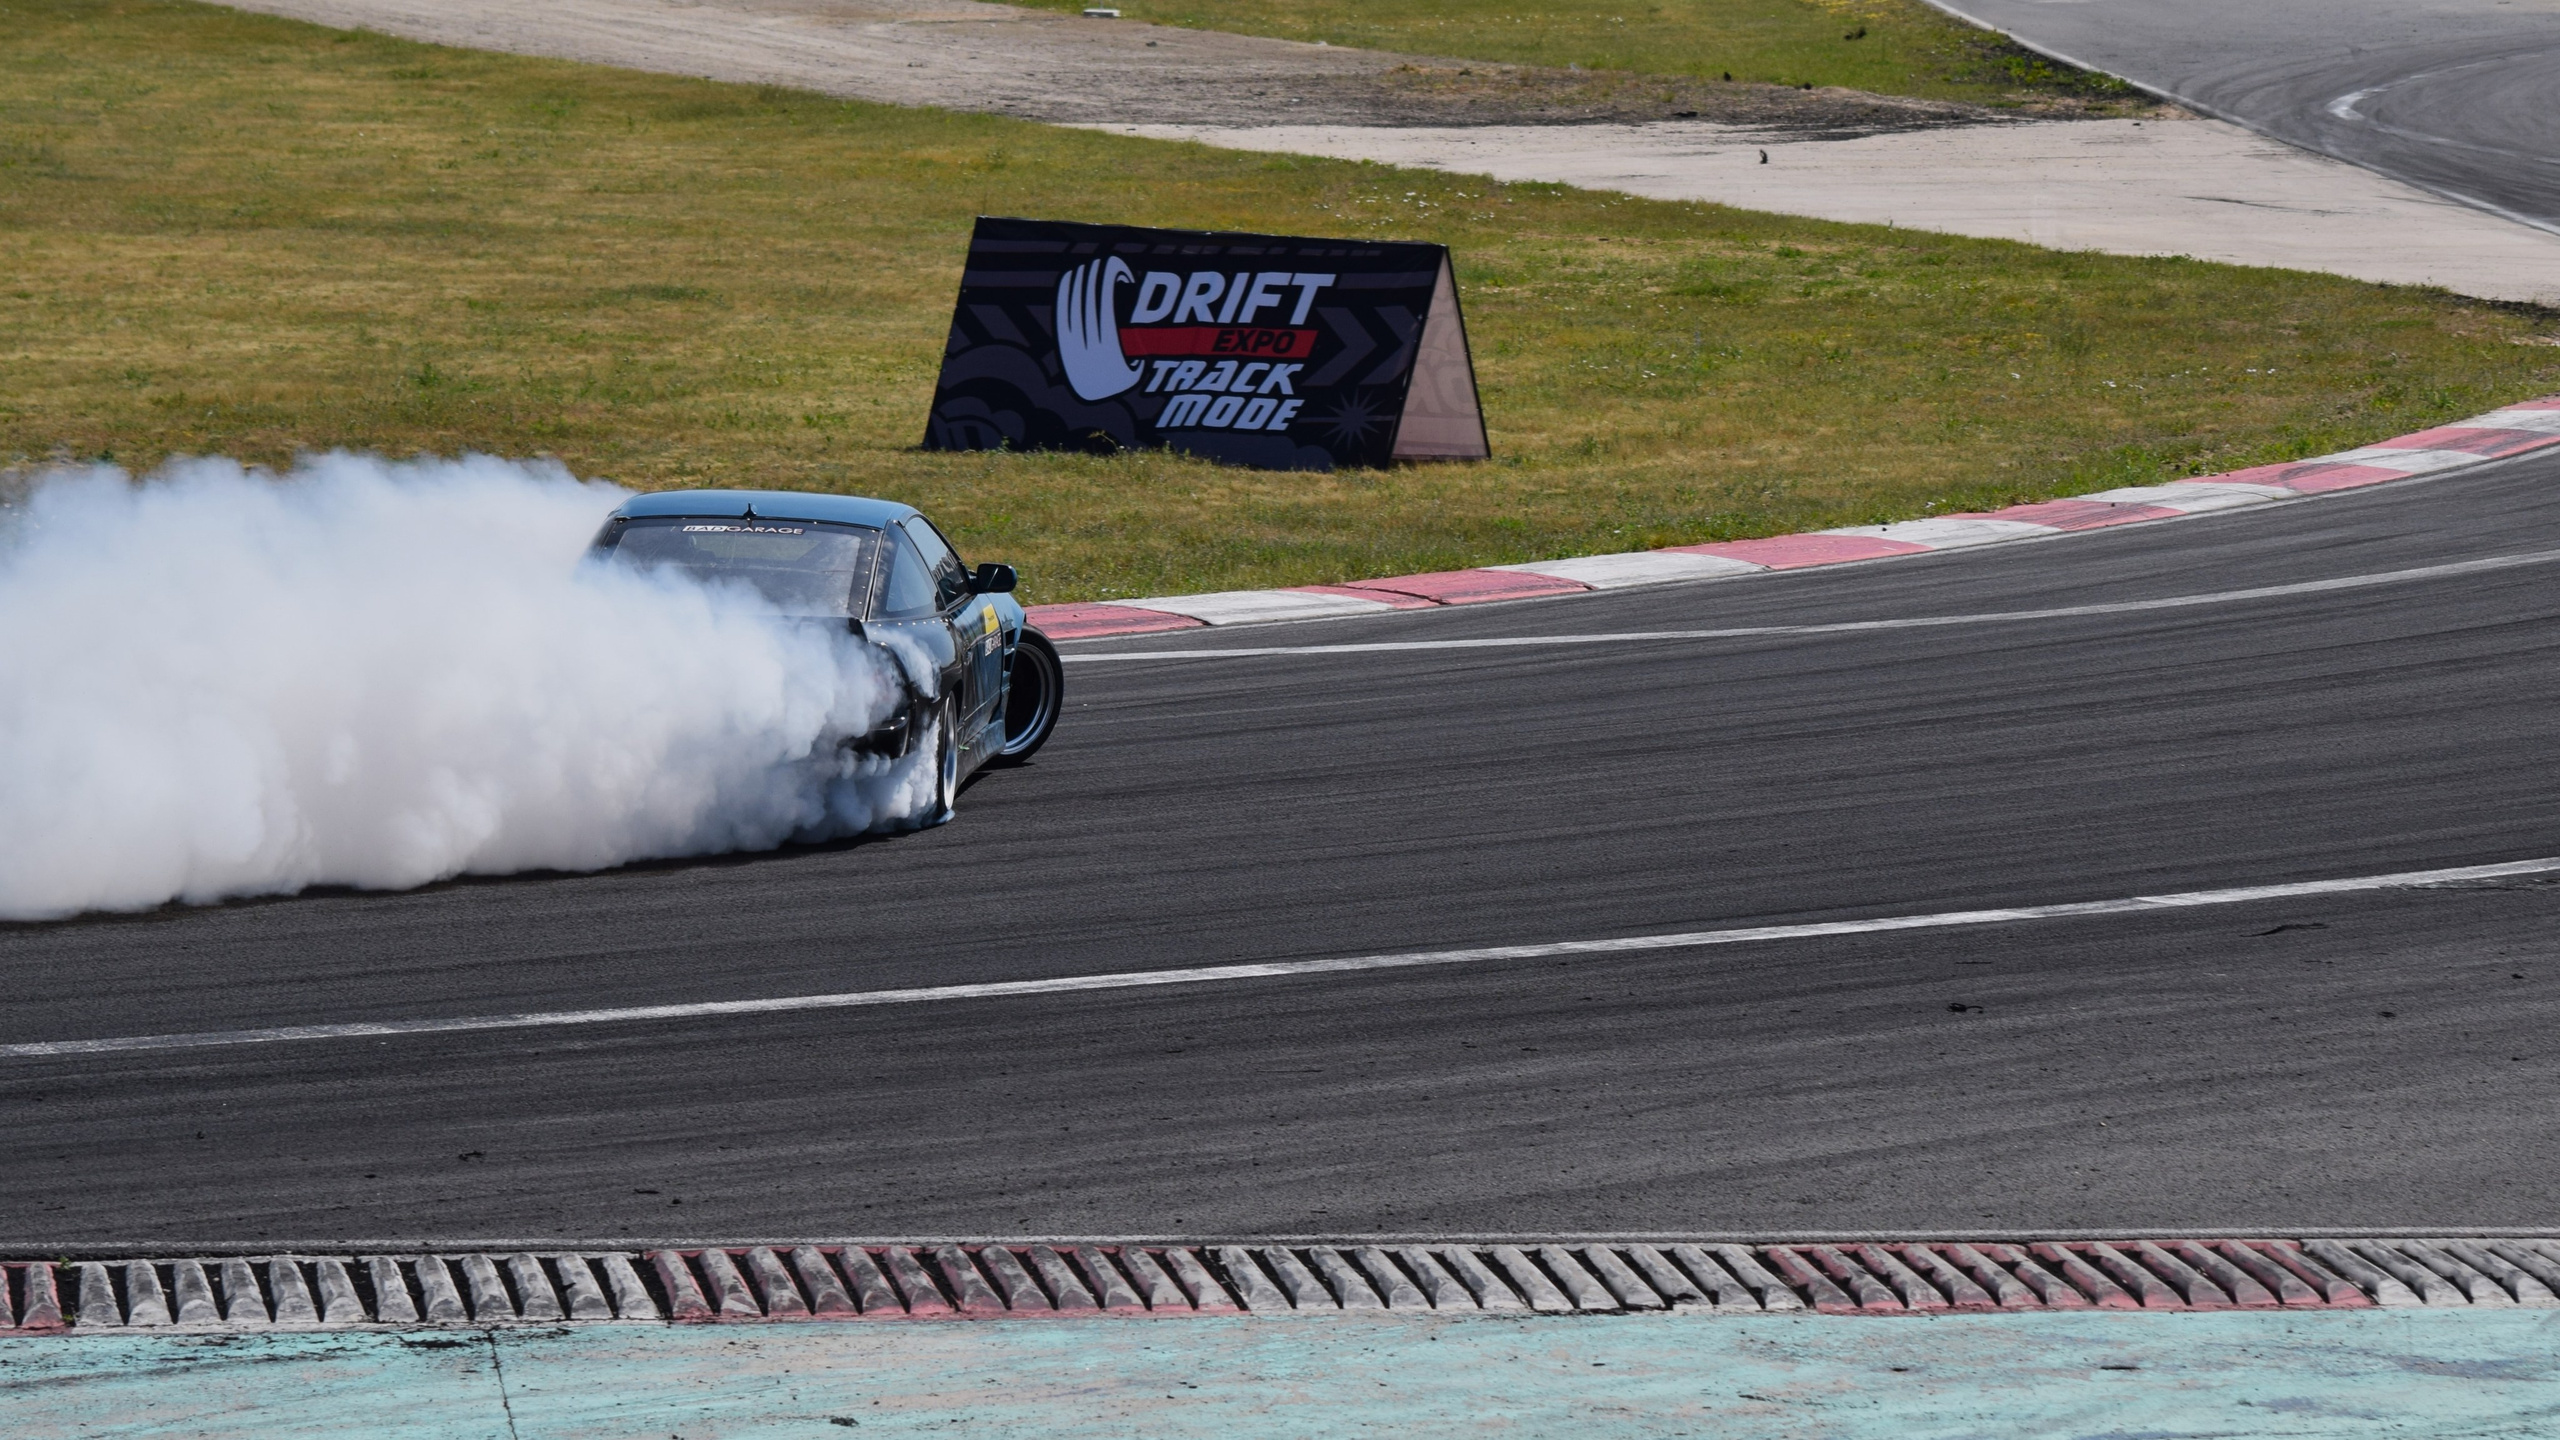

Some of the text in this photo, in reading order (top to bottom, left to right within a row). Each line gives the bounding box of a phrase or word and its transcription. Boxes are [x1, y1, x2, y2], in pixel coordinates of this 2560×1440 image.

[1130, 271, 1336, 325] DRIFT
[1213, 330, 1295, 353] EXPO
[1145, 360, 1304, 395] TRACK
[1156, 395, 1305, 431] MODE
